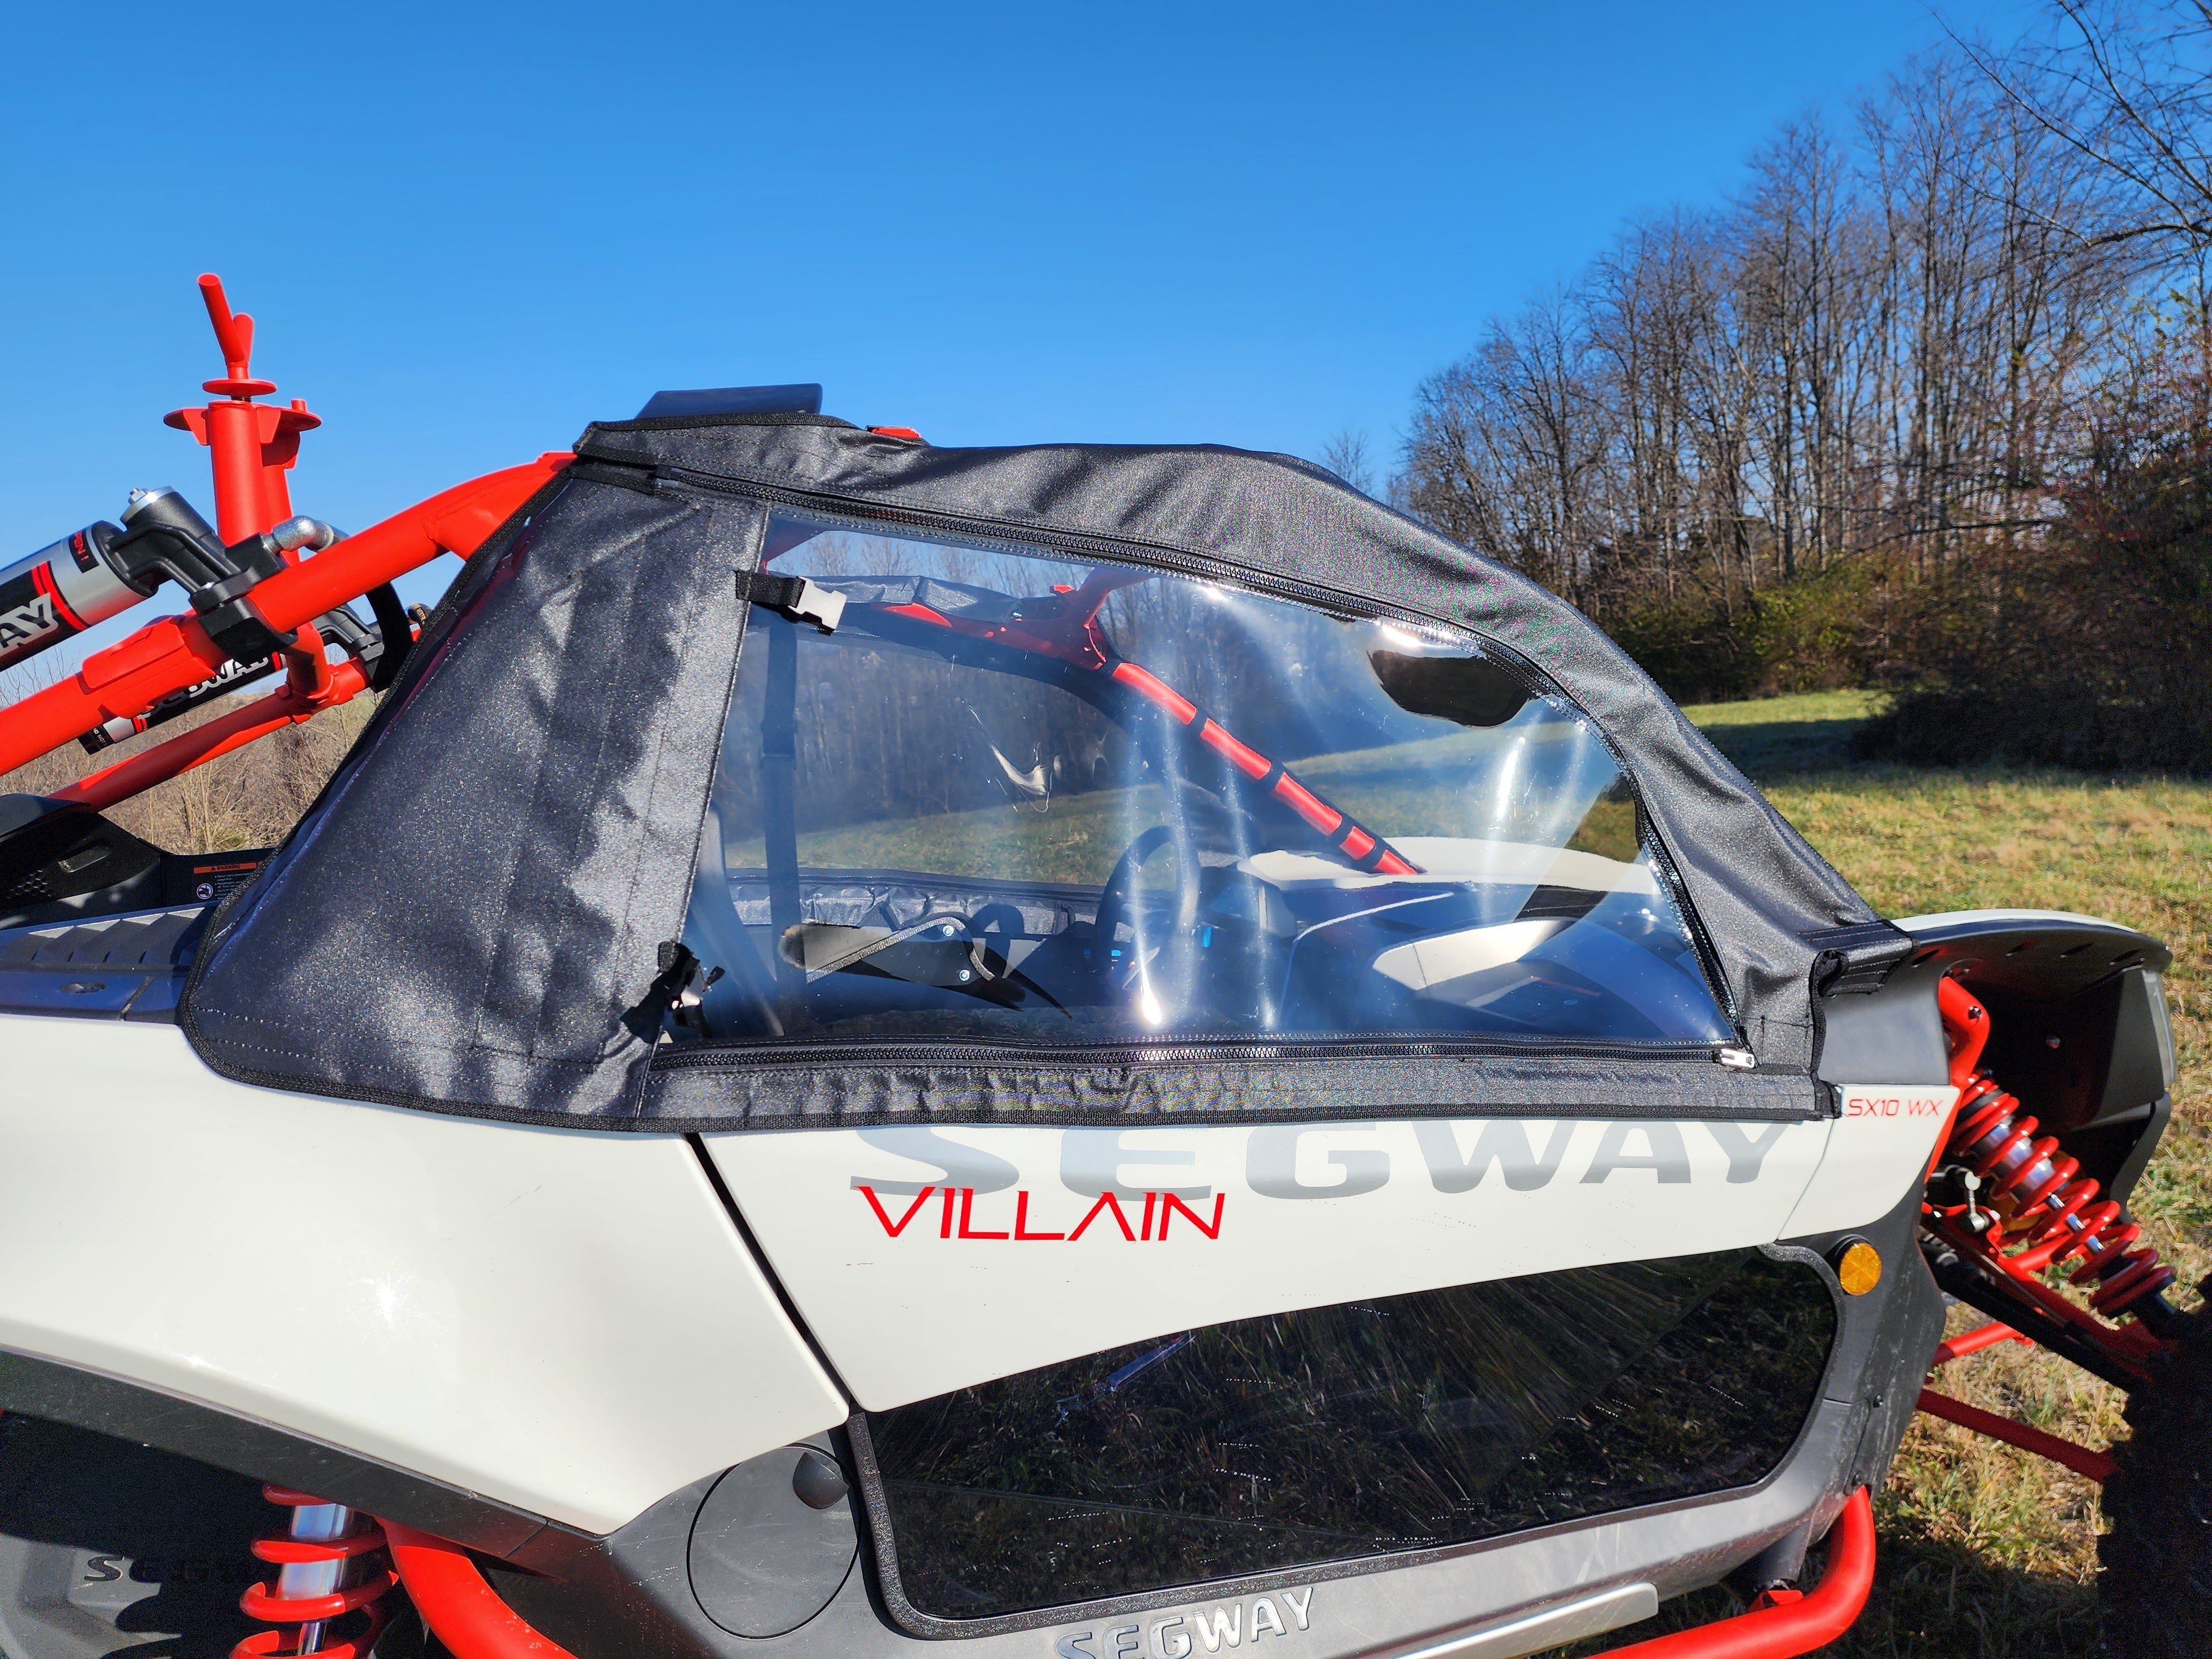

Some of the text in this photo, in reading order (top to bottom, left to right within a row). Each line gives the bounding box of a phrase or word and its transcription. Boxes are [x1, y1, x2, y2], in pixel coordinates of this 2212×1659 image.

[1848, 1099, 1943, 1116] SX10 WX
[850, 1119, 1792, 1201] SEGWAY
[853, 1186, 1225, 1241] VILLAIN
[1055, 1587, 1313, 1659] SEGWAY
